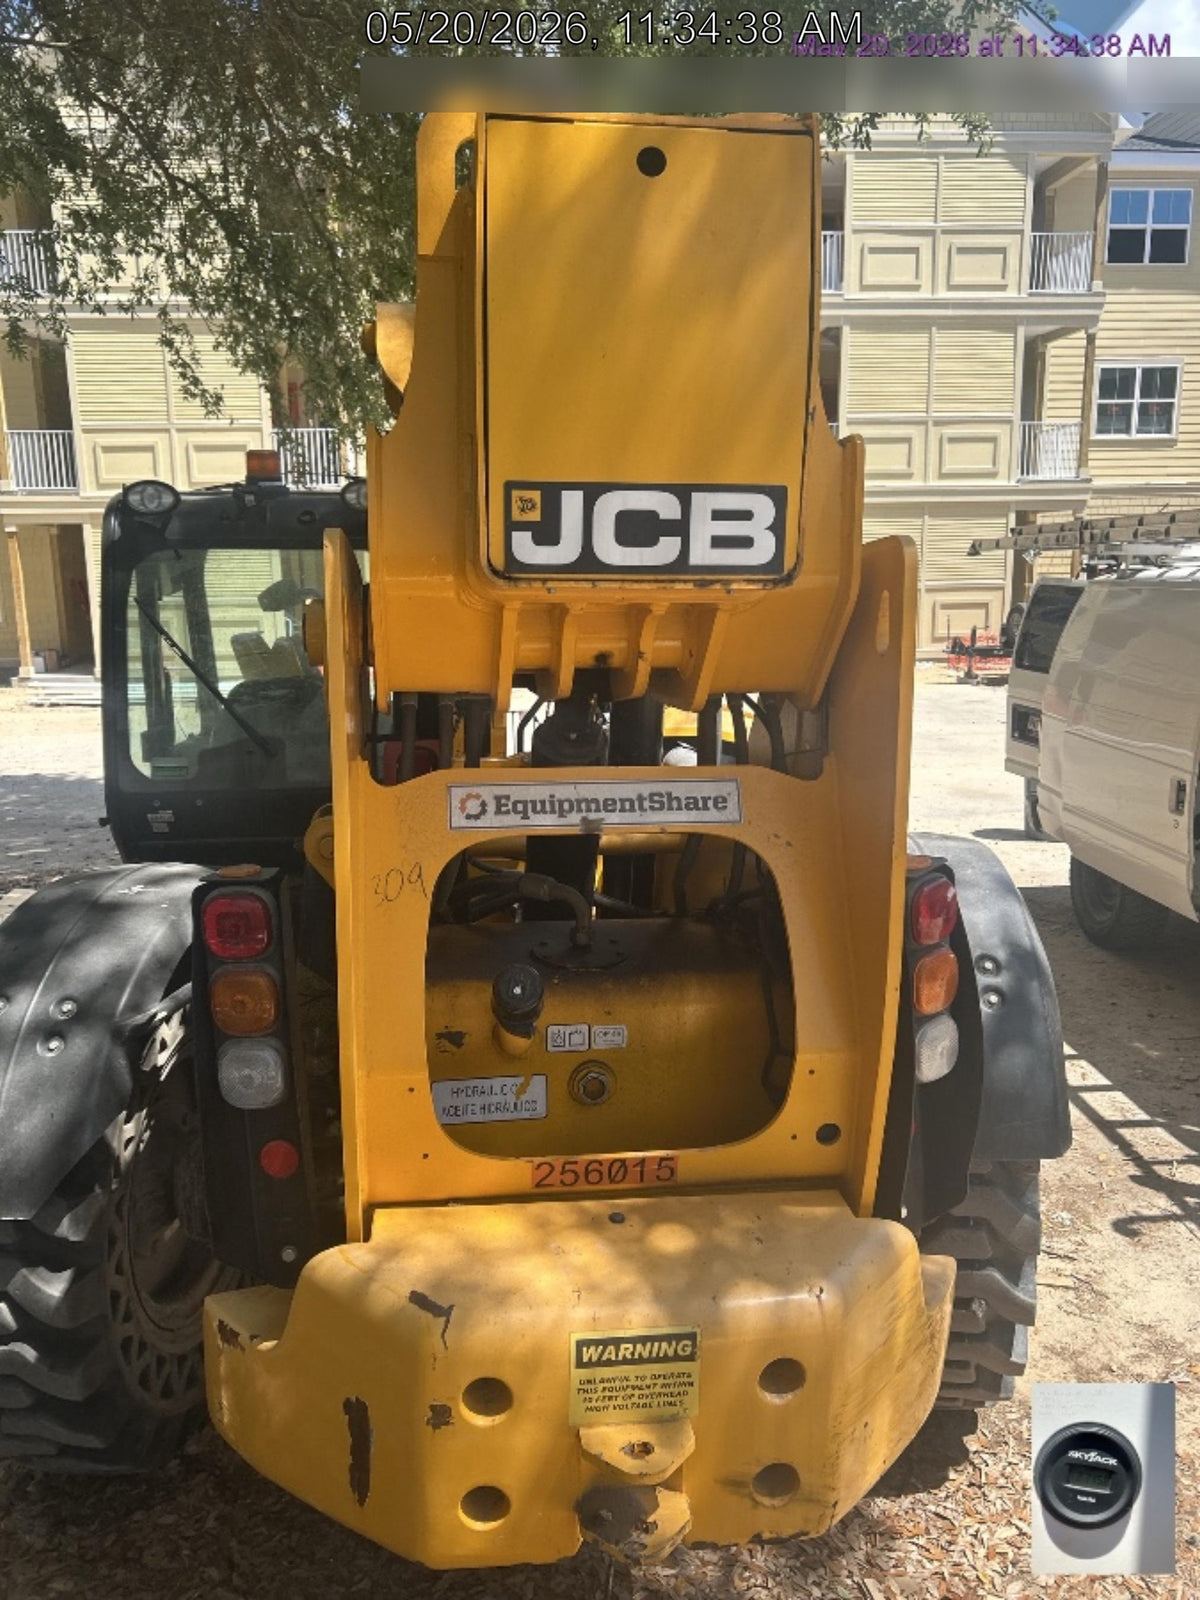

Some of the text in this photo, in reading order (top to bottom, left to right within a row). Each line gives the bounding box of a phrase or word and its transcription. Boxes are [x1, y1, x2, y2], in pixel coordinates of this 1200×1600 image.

[511, 490, 776, 566] JCB
[493, 791, 730, 820] EquipmentShare
[534, 1156, 675, 1188] 256015
[582, 1340, 693, 1363] WARNING
